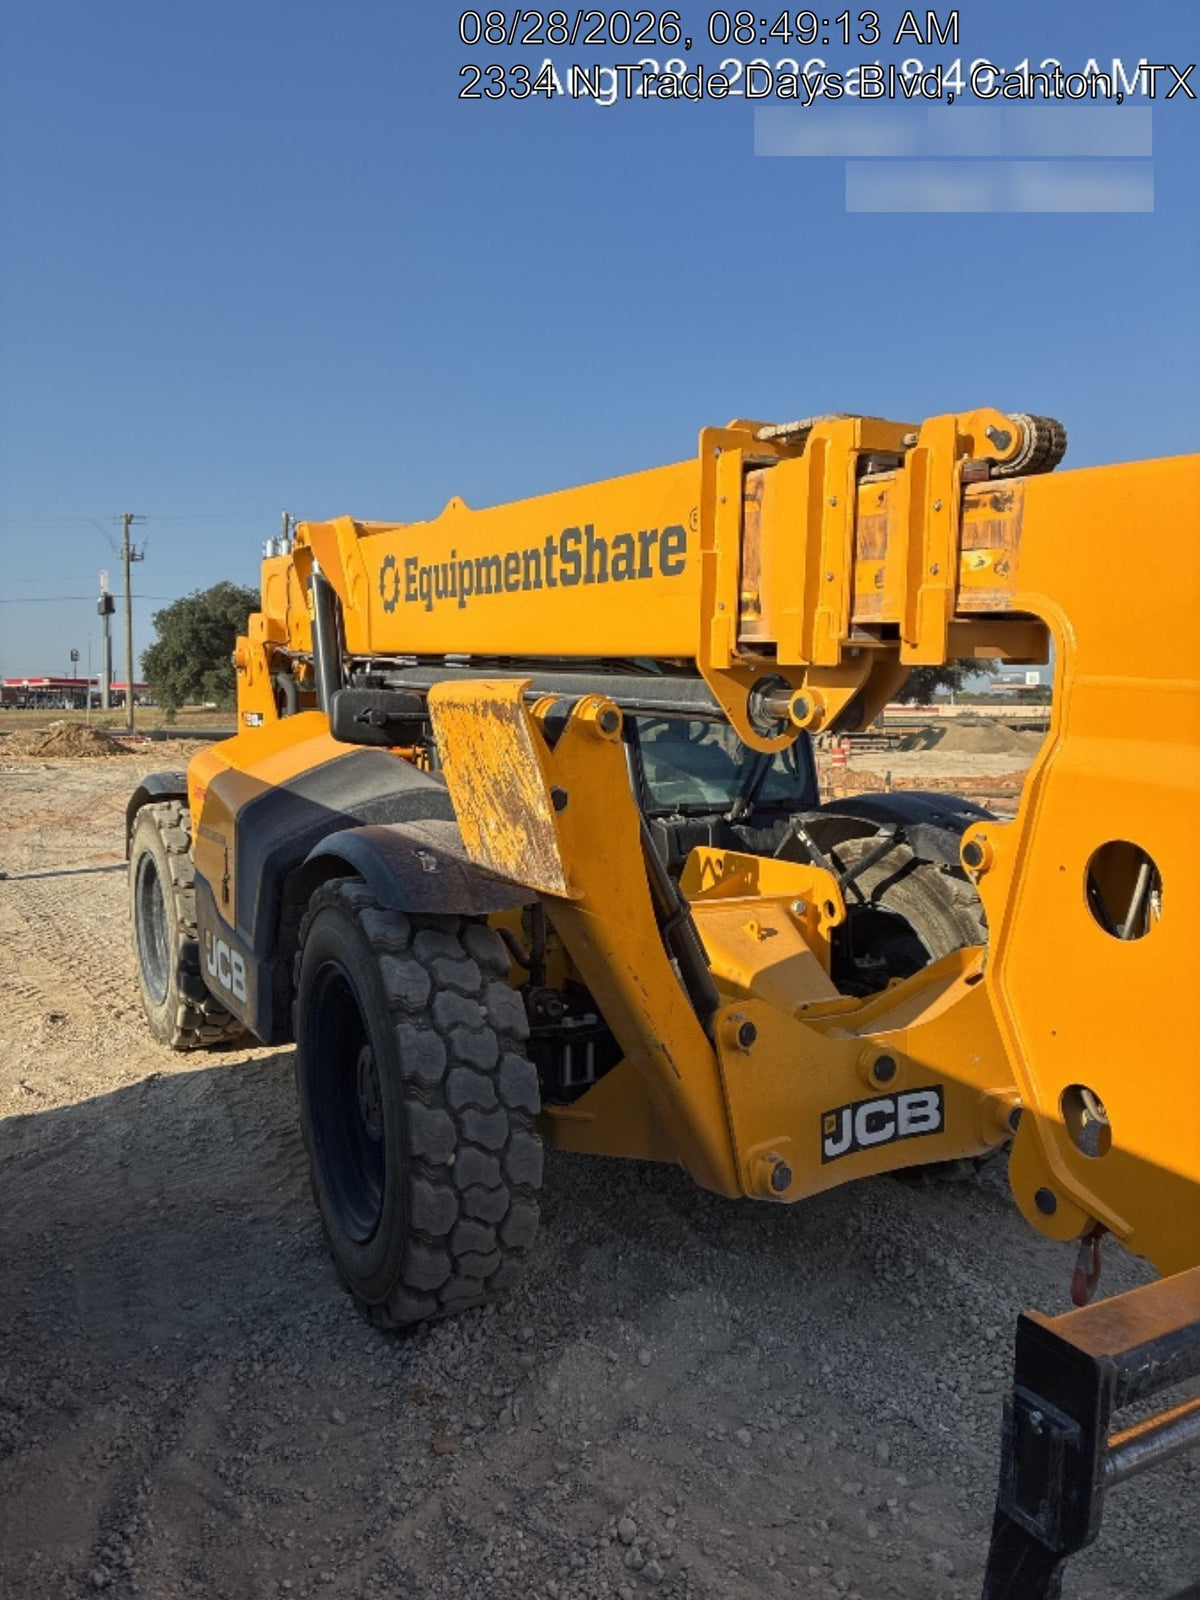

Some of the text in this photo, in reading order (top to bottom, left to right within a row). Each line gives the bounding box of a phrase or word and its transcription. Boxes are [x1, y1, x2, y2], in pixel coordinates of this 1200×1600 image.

[404, 523, 687, 611] EquipmentShare
[206, 933, 248, 1004] JCB
[823, 1088, 942, 1158] JCB
